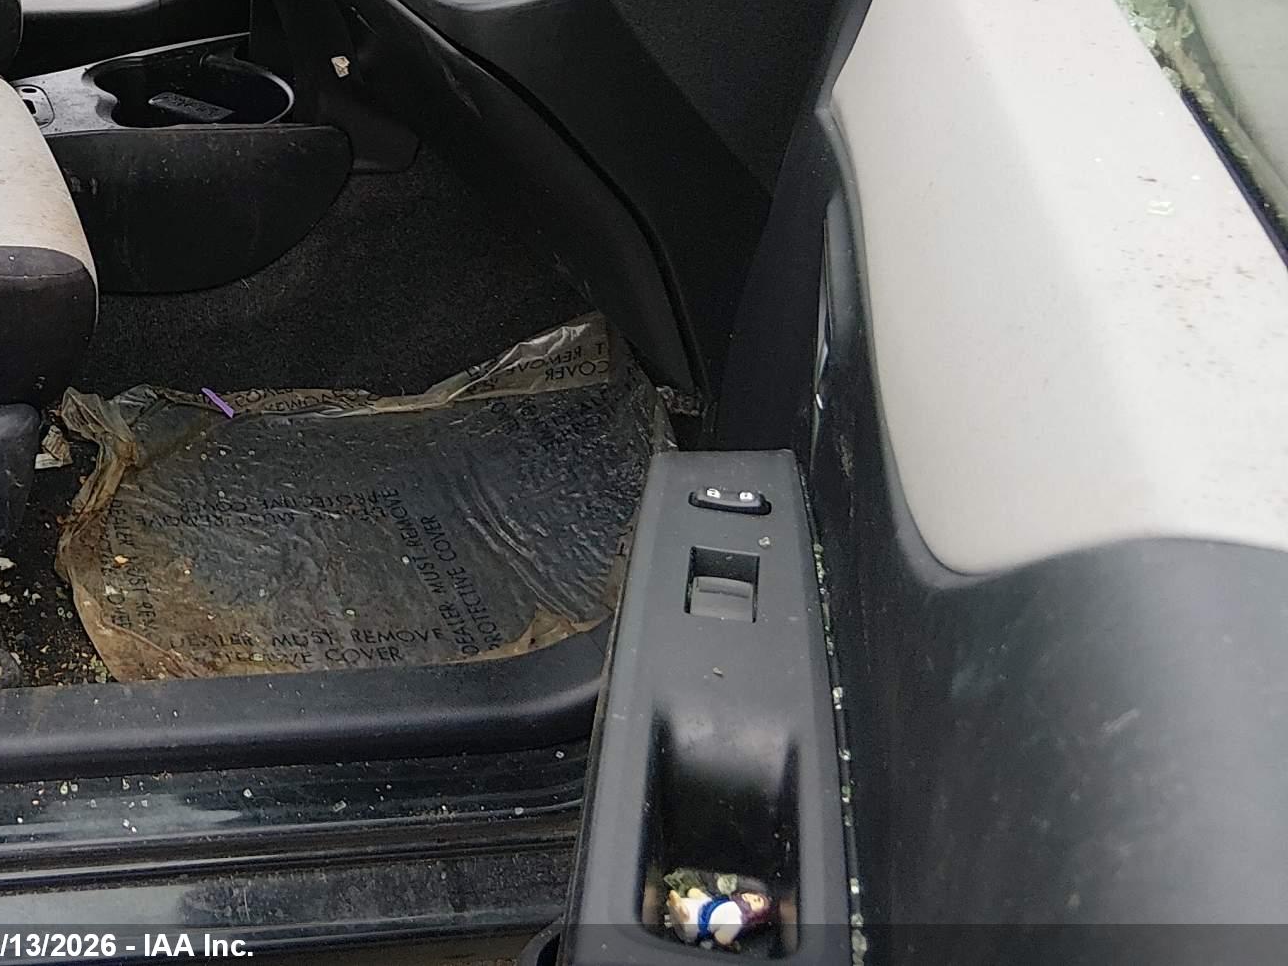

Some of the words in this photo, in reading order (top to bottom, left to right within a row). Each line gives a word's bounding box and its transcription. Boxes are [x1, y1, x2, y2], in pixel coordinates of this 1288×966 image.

[381, 488, 423, 547] REMOVE
[421, 514, 457, 562] COVER
[413, 557, 447, 594] MUST
[272, 628, 334, 647] MUST
[350, 627, 445, 644] REMOVE
[439, 601, 480, 655] DEALER
[325, 646, 404, 663] COVER
